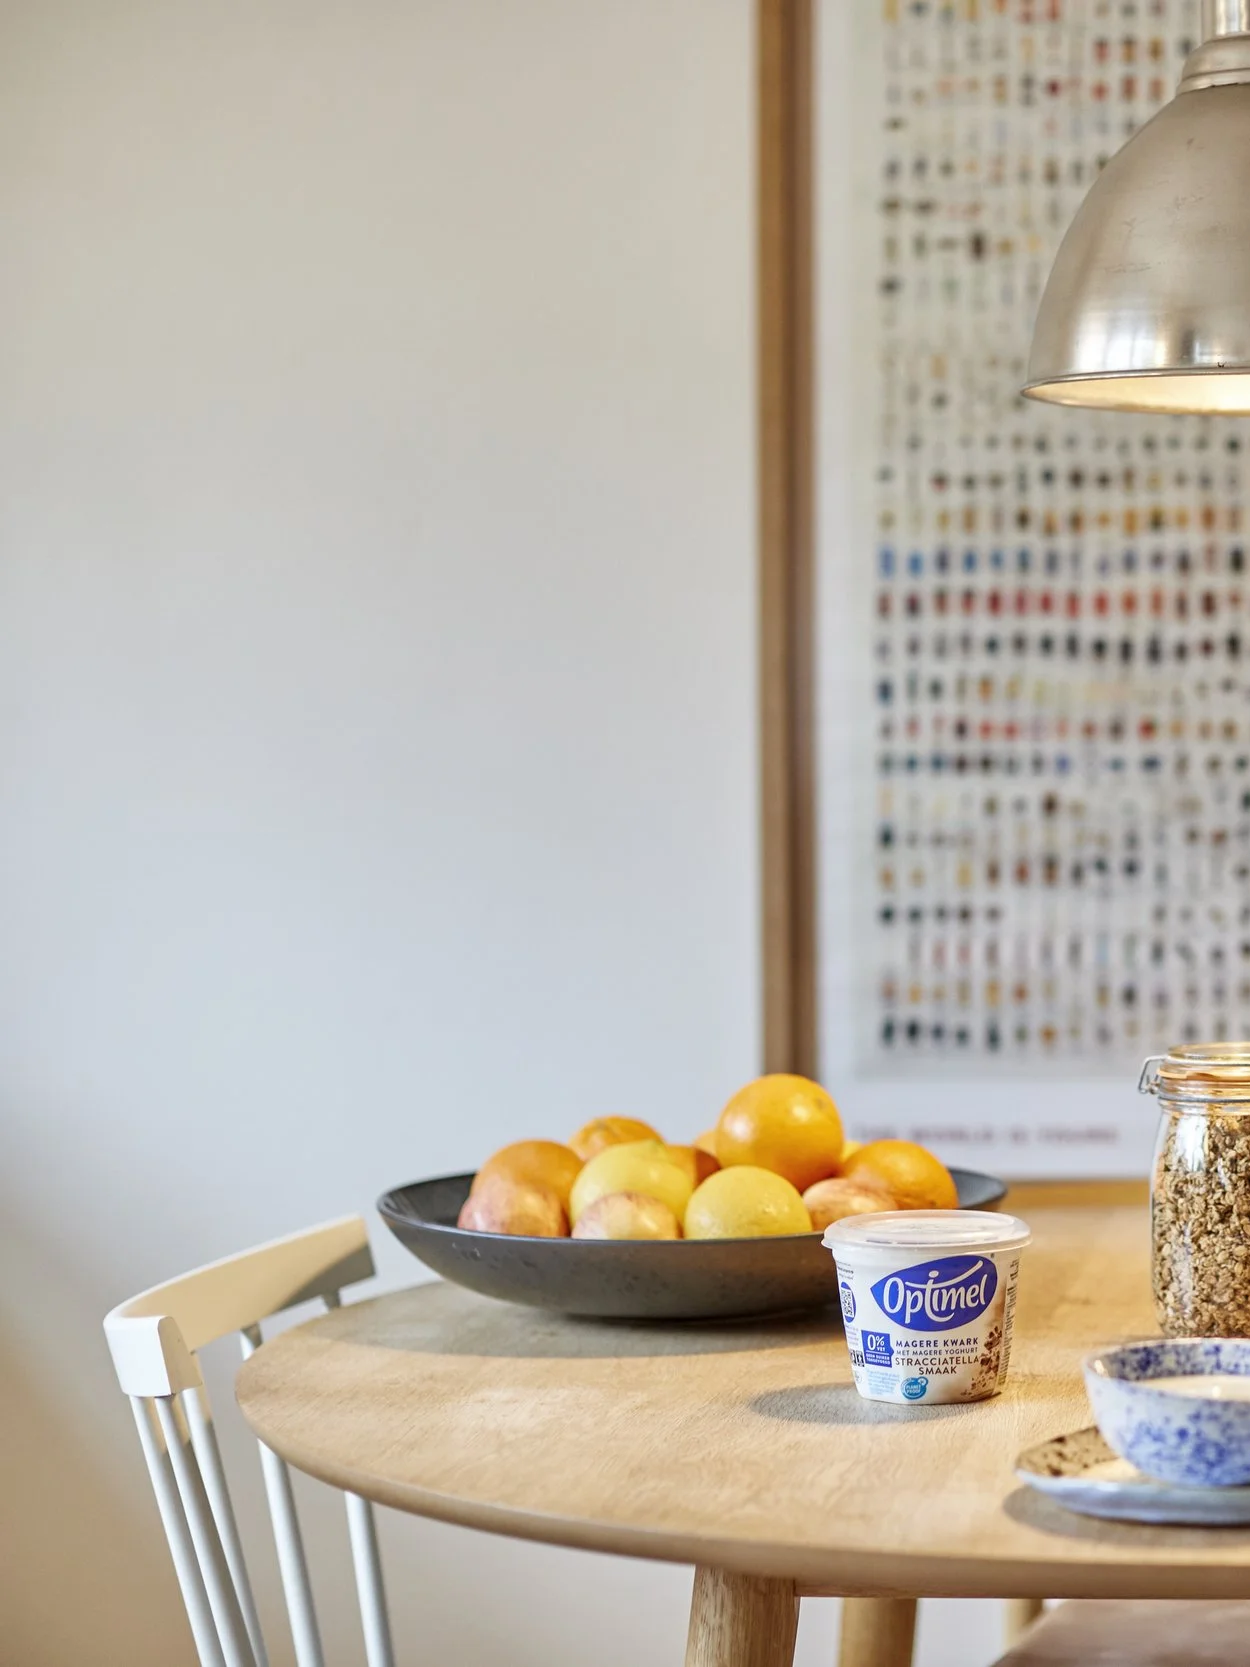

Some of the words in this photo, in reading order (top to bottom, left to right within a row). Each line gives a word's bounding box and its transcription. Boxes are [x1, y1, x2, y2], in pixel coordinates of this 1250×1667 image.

[883, 1260, 987, 1324] Optimel
[867, 1334, 885, 1351] 0%
[895, 1340, 939, 1348] MAGERE
[943, 1337, 979, 1347] KWARK
[945, 1347, 979, 1355] YOGHURT
[895, 1355, 980, 1366] STRACCIATELLA
[918, 1366, 958, 1376] SMAAK
